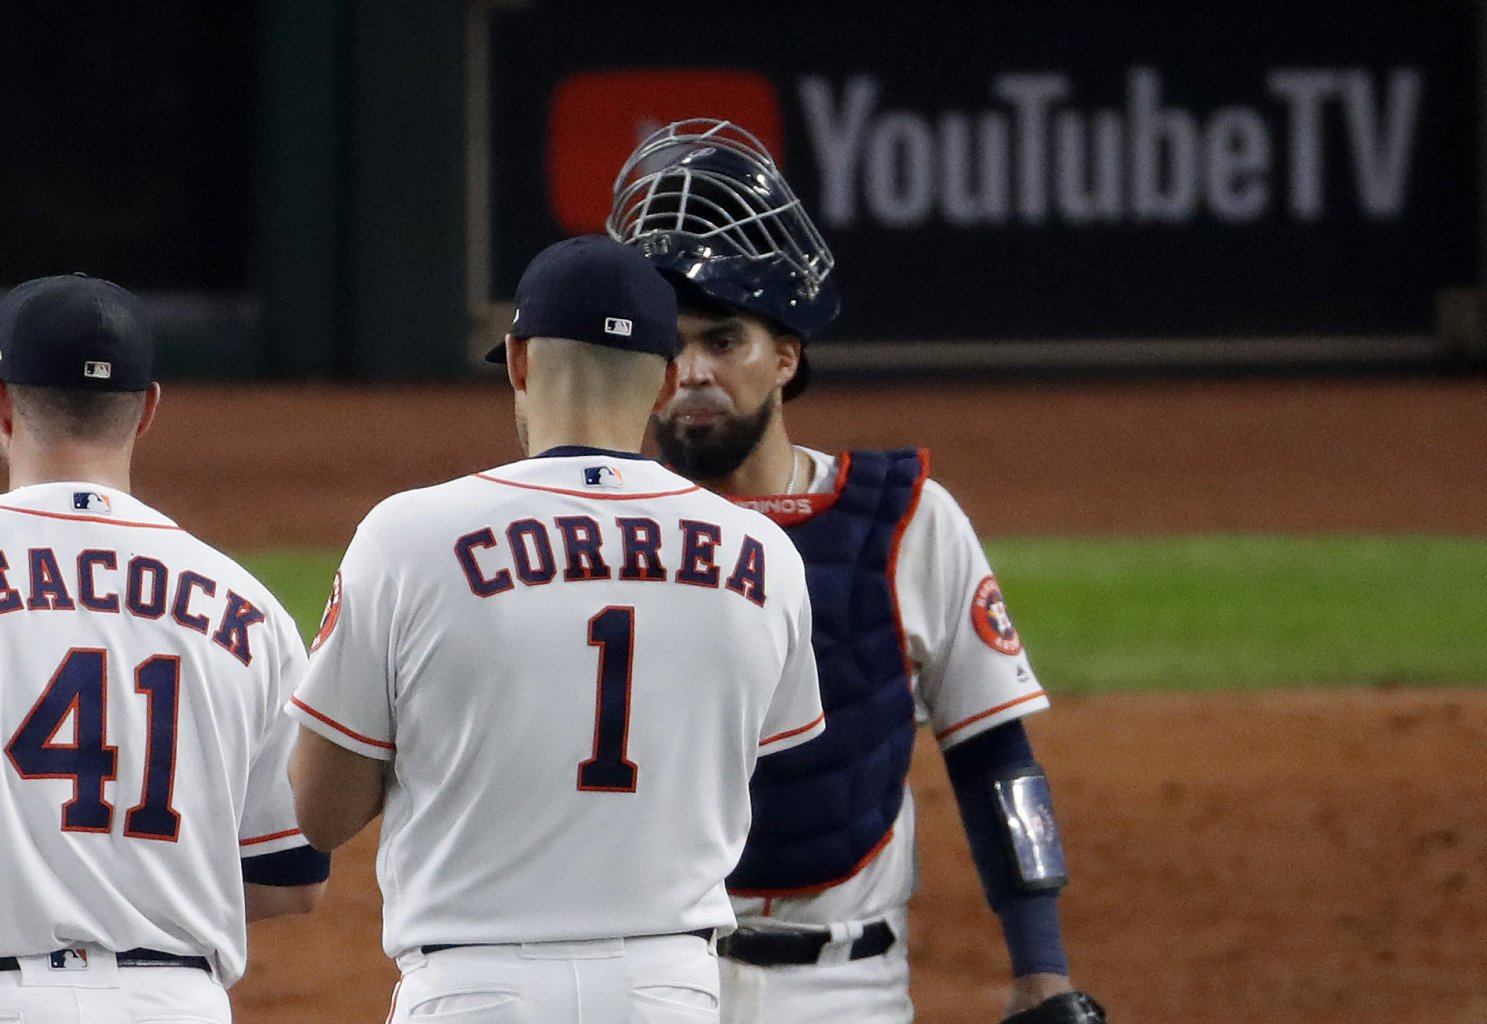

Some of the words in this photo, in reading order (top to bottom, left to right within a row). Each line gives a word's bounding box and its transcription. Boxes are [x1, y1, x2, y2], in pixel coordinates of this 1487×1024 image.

[453, 515, 767, 607] CORREA
[4, 647, 181, 842] 41
[577, 605, 638, 793] 1
